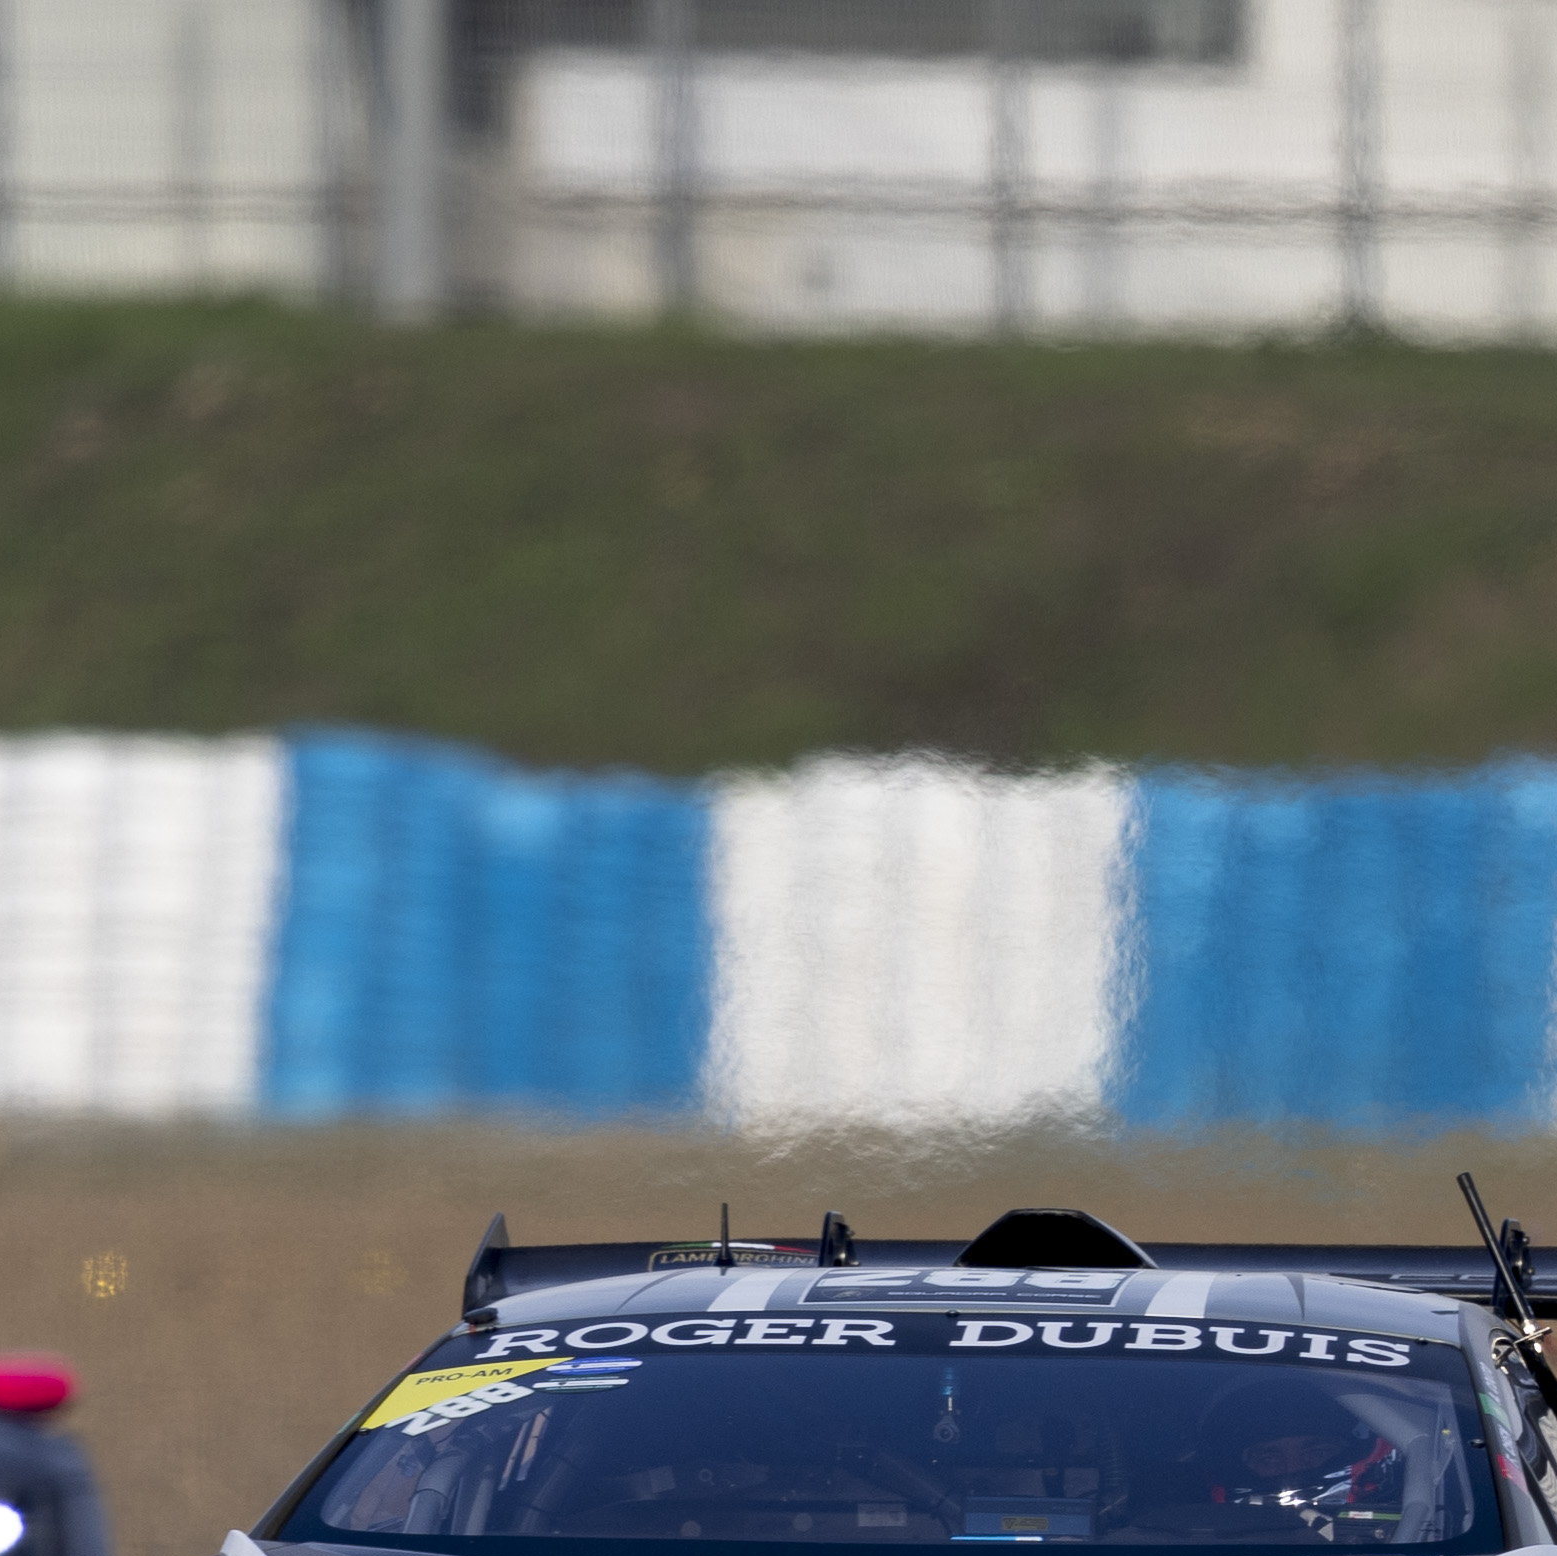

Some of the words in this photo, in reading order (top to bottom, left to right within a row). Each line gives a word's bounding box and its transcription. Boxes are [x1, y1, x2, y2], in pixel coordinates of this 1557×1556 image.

[816, 1269, 1127, 1290] 288
[474, 1318, 895, 1359] ROGER
[949, 1320, 1410, 1367] DUBUIS
[415, 1367, 513, 1386] PRO-AM
[384, 1381, 534, 1436] 288
